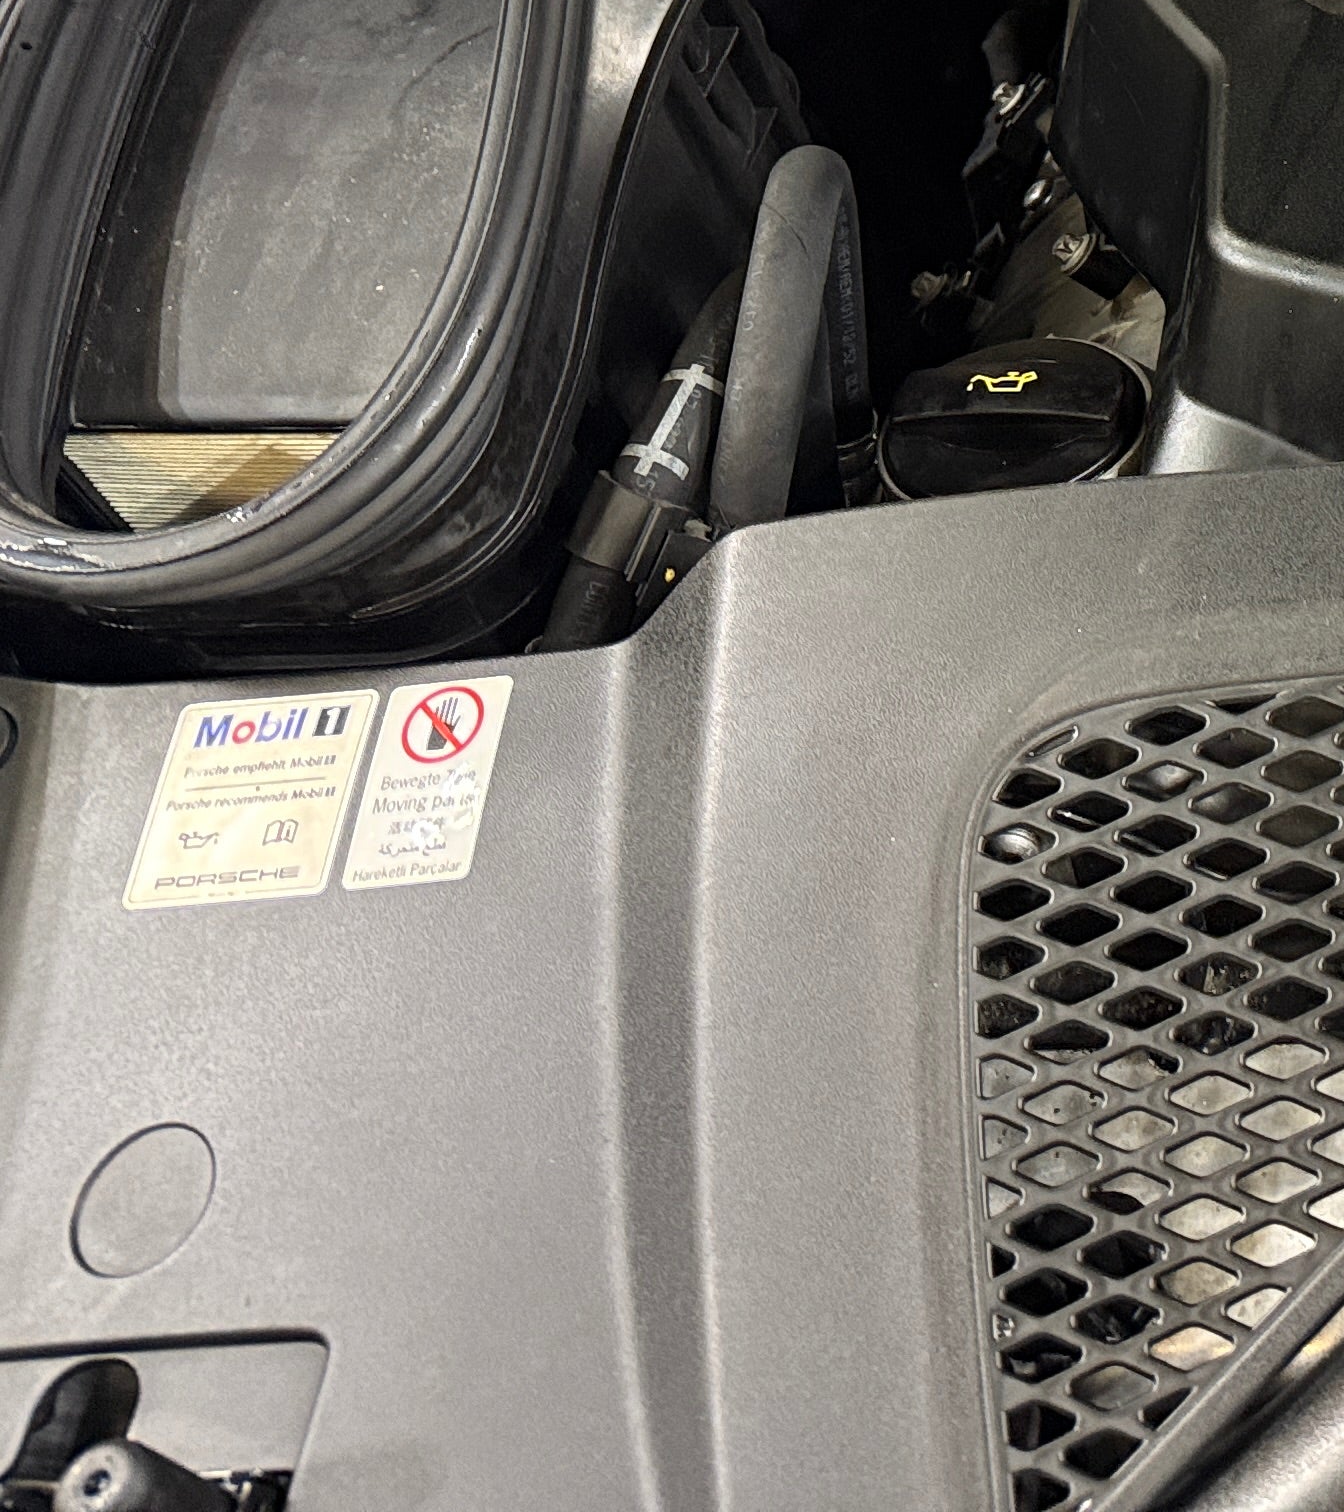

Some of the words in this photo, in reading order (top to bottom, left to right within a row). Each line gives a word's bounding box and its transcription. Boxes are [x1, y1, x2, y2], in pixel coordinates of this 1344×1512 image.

[193, 707, 309, 748] Mobil
[380, 773, 441, 791] Bewegte
[372, 796, 428, 814] Moving
[155, 866, 301, 890] PORSCHE
[352, 865, 407, 882] Hareketli
